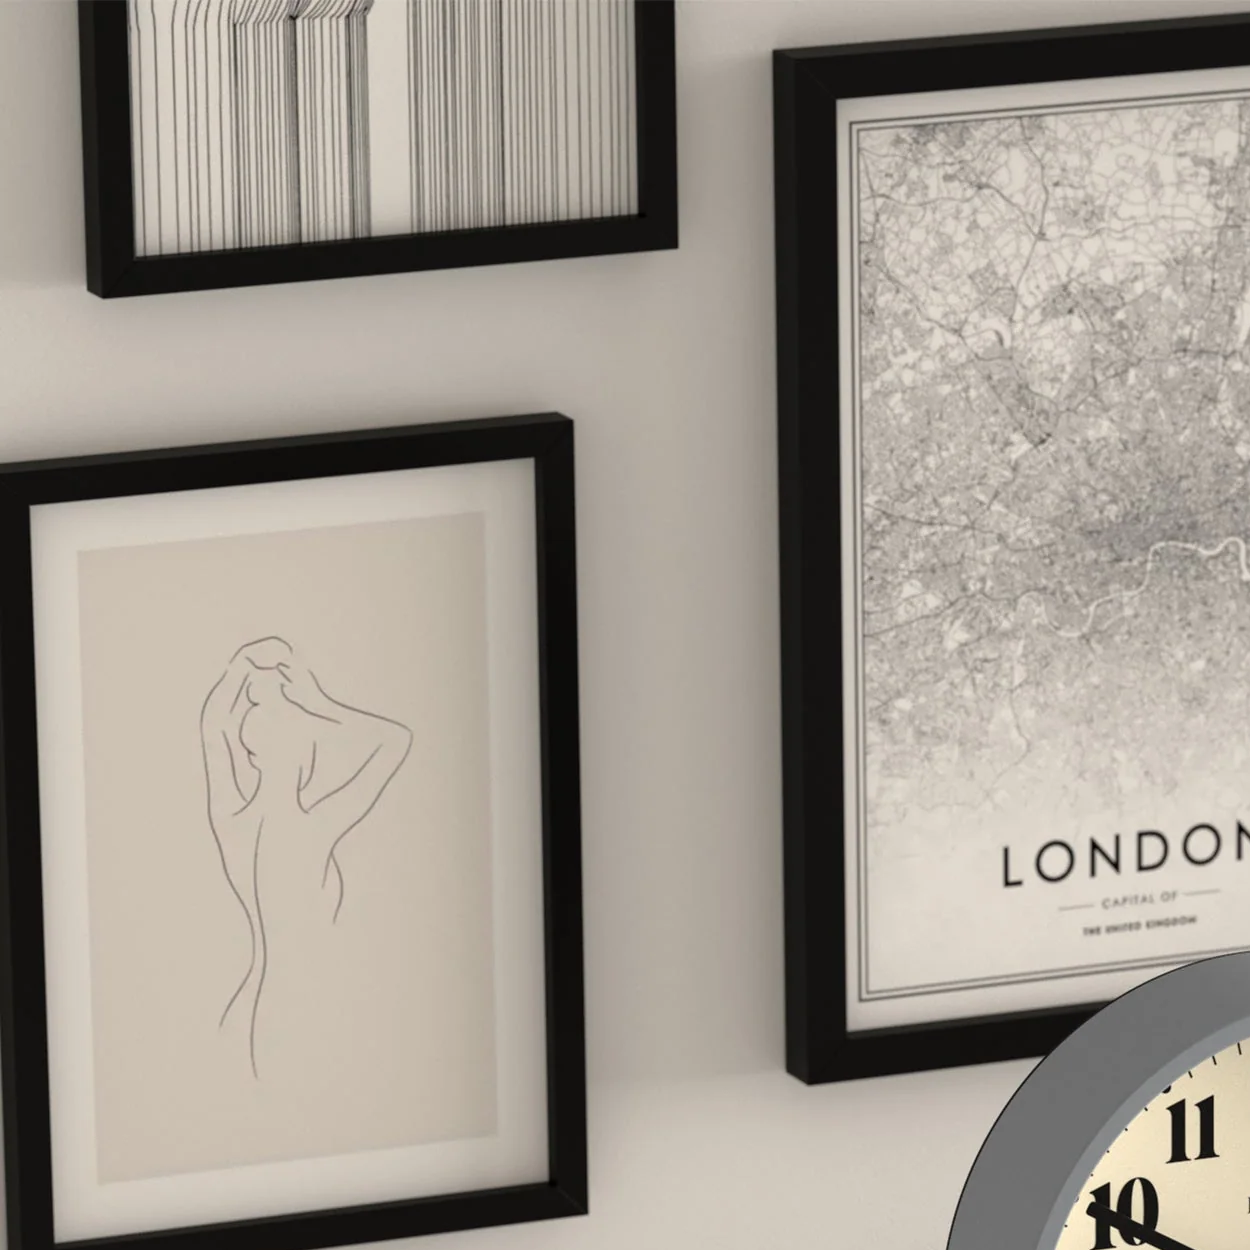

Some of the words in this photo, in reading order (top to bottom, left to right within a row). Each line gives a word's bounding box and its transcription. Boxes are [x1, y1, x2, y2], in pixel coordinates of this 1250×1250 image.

[1101, 894, 1154, 909] CAPITAL
[1160, 890, 1178, 903] OF
[1082, 926, 1101, 936] THE
[1146, 915, 1197, 930] KINGDOM
[1165, 1094, 1221, 1164] 11
[1089, 1177, 1159, 1250] 10
